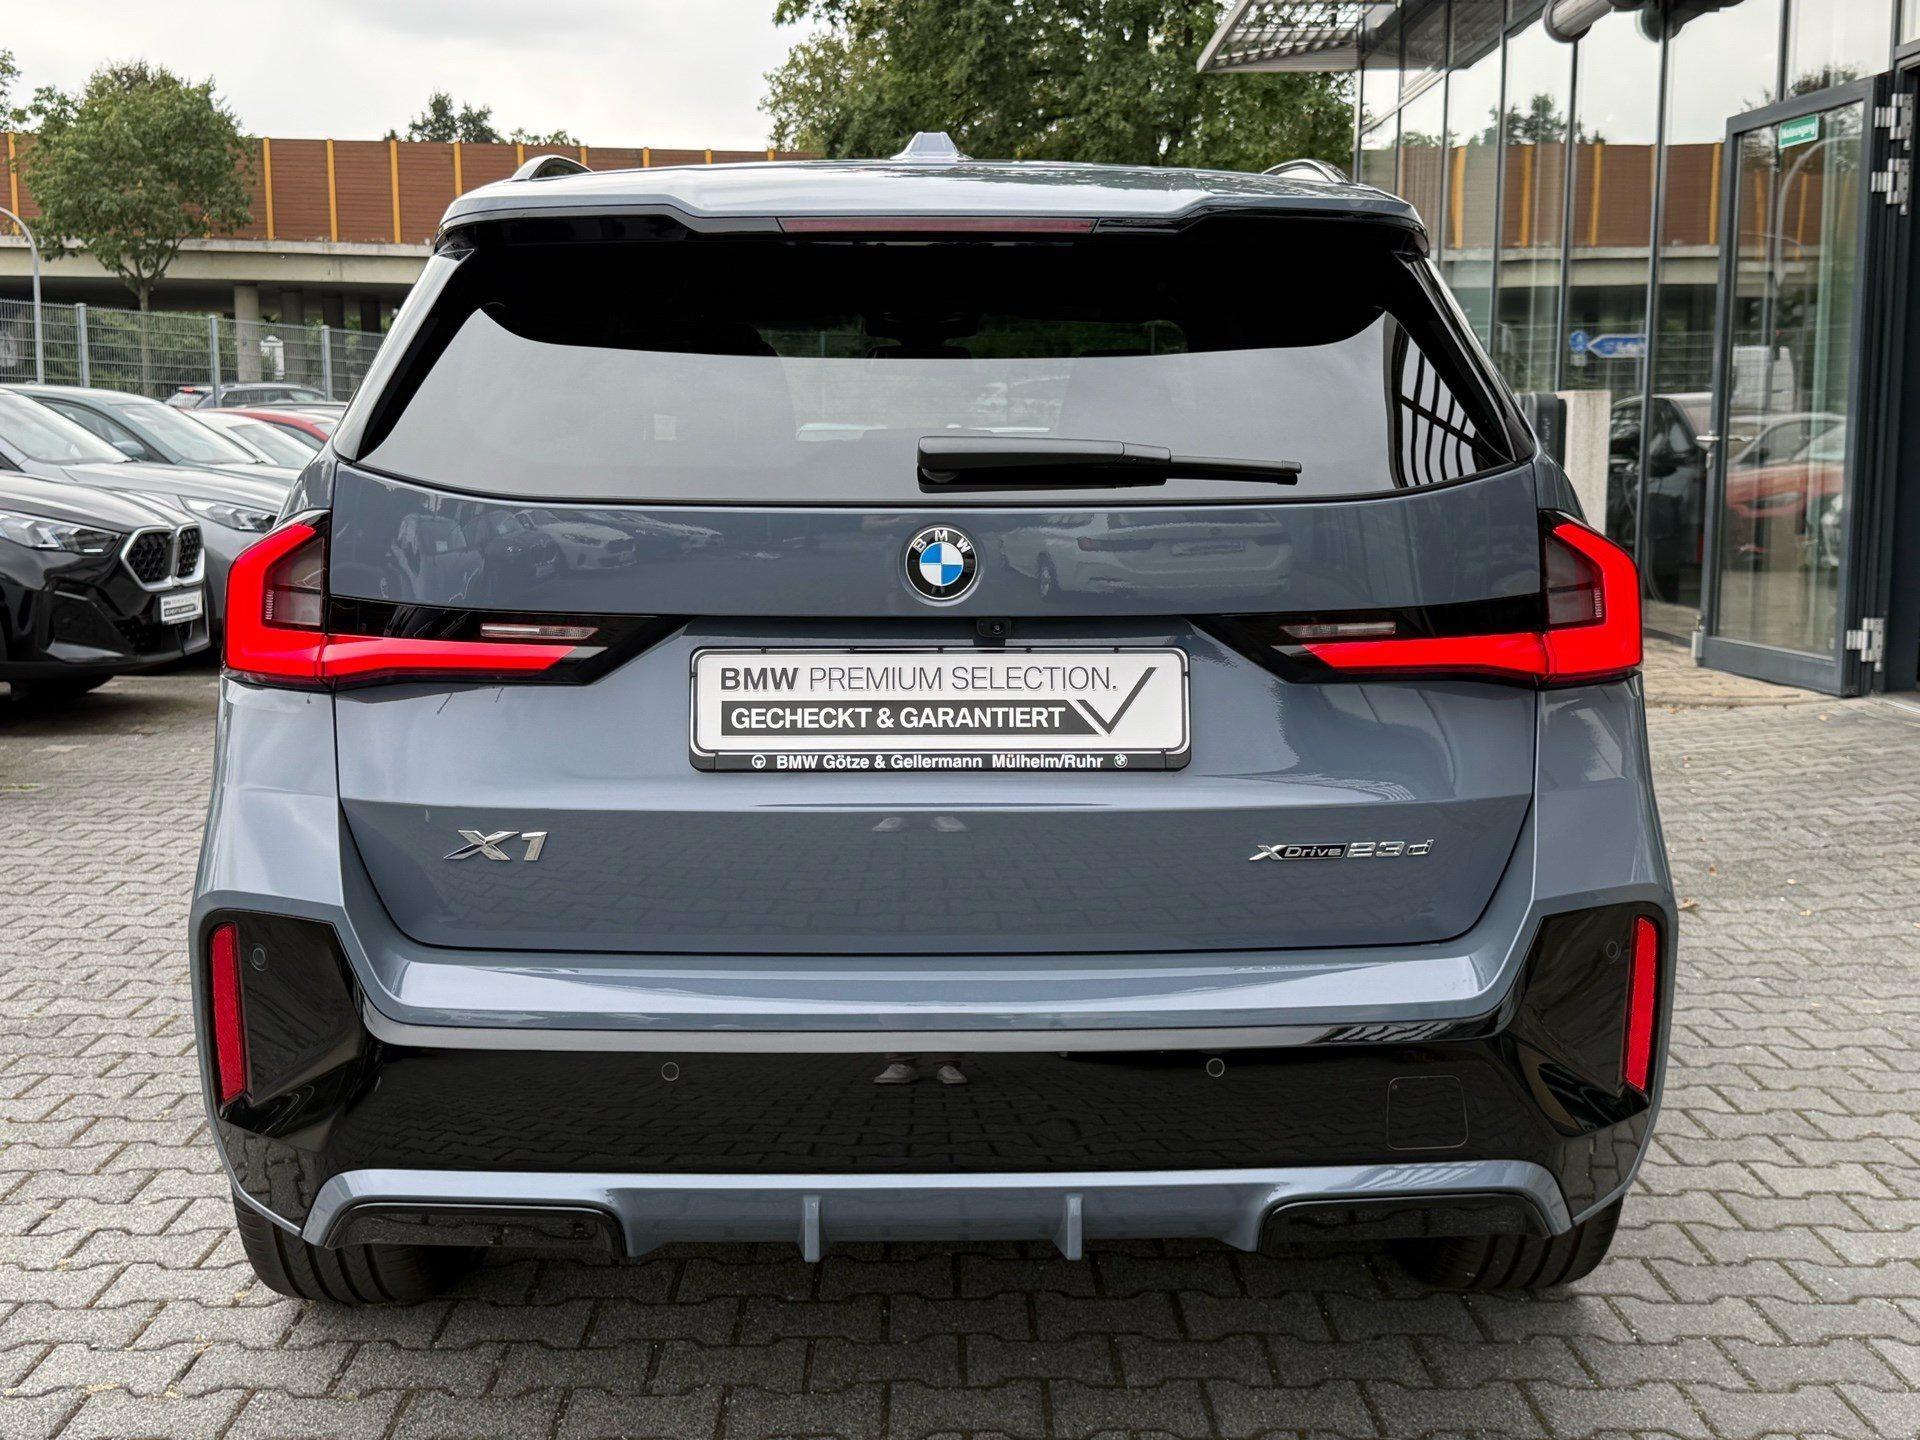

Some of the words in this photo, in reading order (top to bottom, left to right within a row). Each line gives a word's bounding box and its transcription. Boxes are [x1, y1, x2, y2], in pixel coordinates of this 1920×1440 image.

[912, 529, 971, 553] BMW
[721, 667, 799, 690] BMW
[809, 667, 942, 690] PREMIUM
[951, 666, 1118, 690] SELECTION.
[731, 707, 872, 729] GECHECKT
[876, 707, 894, 729] &
[900, 707, 1066, 729] GARANTIERT
[776, 755, 818, 769] BMW
[823, 754, 870, 769] Götze
[874, 755, 886, 769] &
[890, 754, 983, 769] Gellermann
[992, 753, 1104, 769] Mülheim/Ruhr
[443, 829, 548, 861] X1
